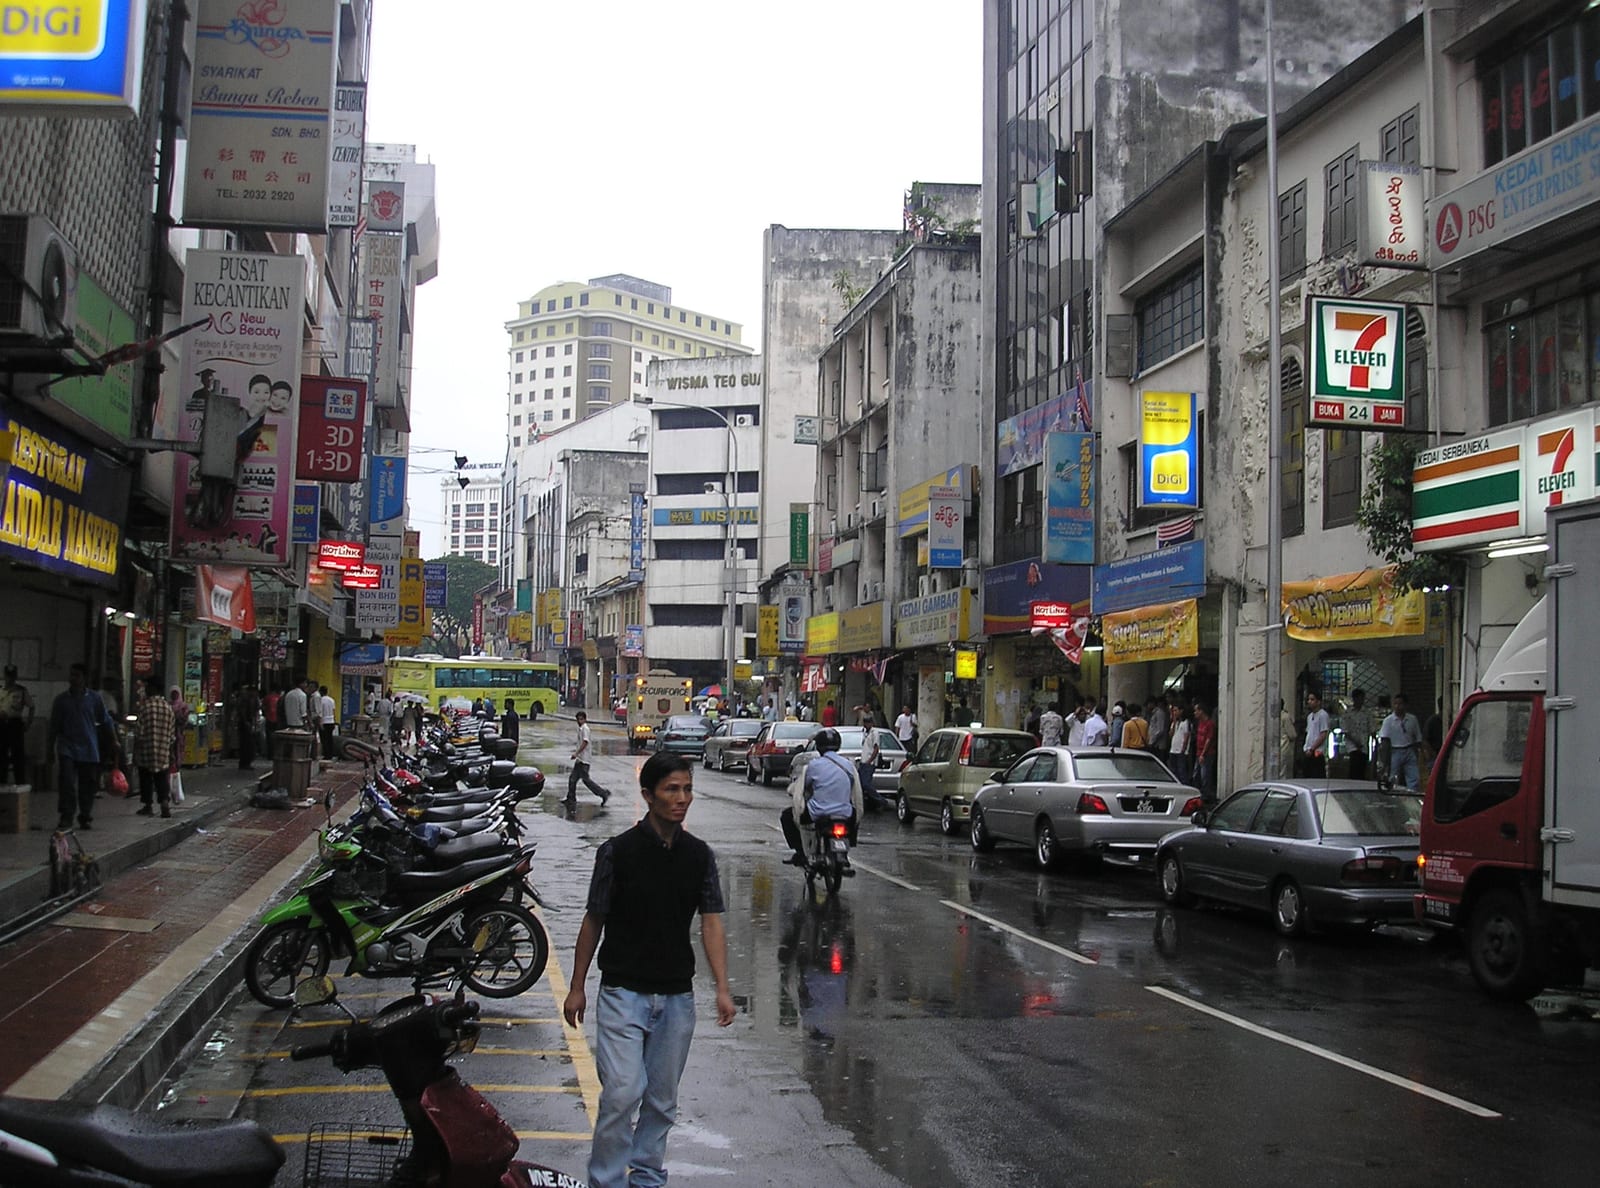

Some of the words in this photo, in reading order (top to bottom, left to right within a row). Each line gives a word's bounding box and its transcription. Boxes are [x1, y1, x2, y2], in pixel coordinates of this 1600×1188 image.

[2, 5, 82, 36] DiGi
[224, 18, 305, 51] Bunga
[201, 65, 263, 80] SYARIKAT
[200, 85, 258, 107] Bunga
[265, 87, 320, 106] Reben
[335, 89, 363, 112] EROBIK
[202, 168, 312, 184] 有限公司
[1494, 152, 1543, 195] KEDAI
[242, 189, 267, 200] 2032
[271, 191, 295, 201] 2920
[1503, 162, 1583, 219] ENTERPRISE
[1468, 200, 1496, 238] PSG
[219, 256, 268, 282] PUSAT
[193, 282, 290, 309] KECANTIKAN
[240, 312, 266, 324] New
[239, 324, 281, 339] Beauty
[350, 321, 373, 348] TABIB
[666, 376, 709, 390] WISMA
[713, 374, 736, 388] TEO
[1319, 404, 1340, 417] BUKA
[1349, 406, 1368, 420] 24
[1380, 409, 1396, 420] JAM
[324, 425, 354, 447] 3D
[306, 449, 352, 472] 1+3D
[1417, 454, 1439, 466] KEDAI
[1442, 438, 1490, 461] SERBANEKA
[1157, 473, 1182, 485] DiGi
[360, 592, 376, 600] SDN
[378, 592, 397, 600] BHD
[899, 601, 921, 619] KEDAI
[922, 591, 959, 614] GAMBAR
[639, 686, 689, 696] SECURIFORCE
